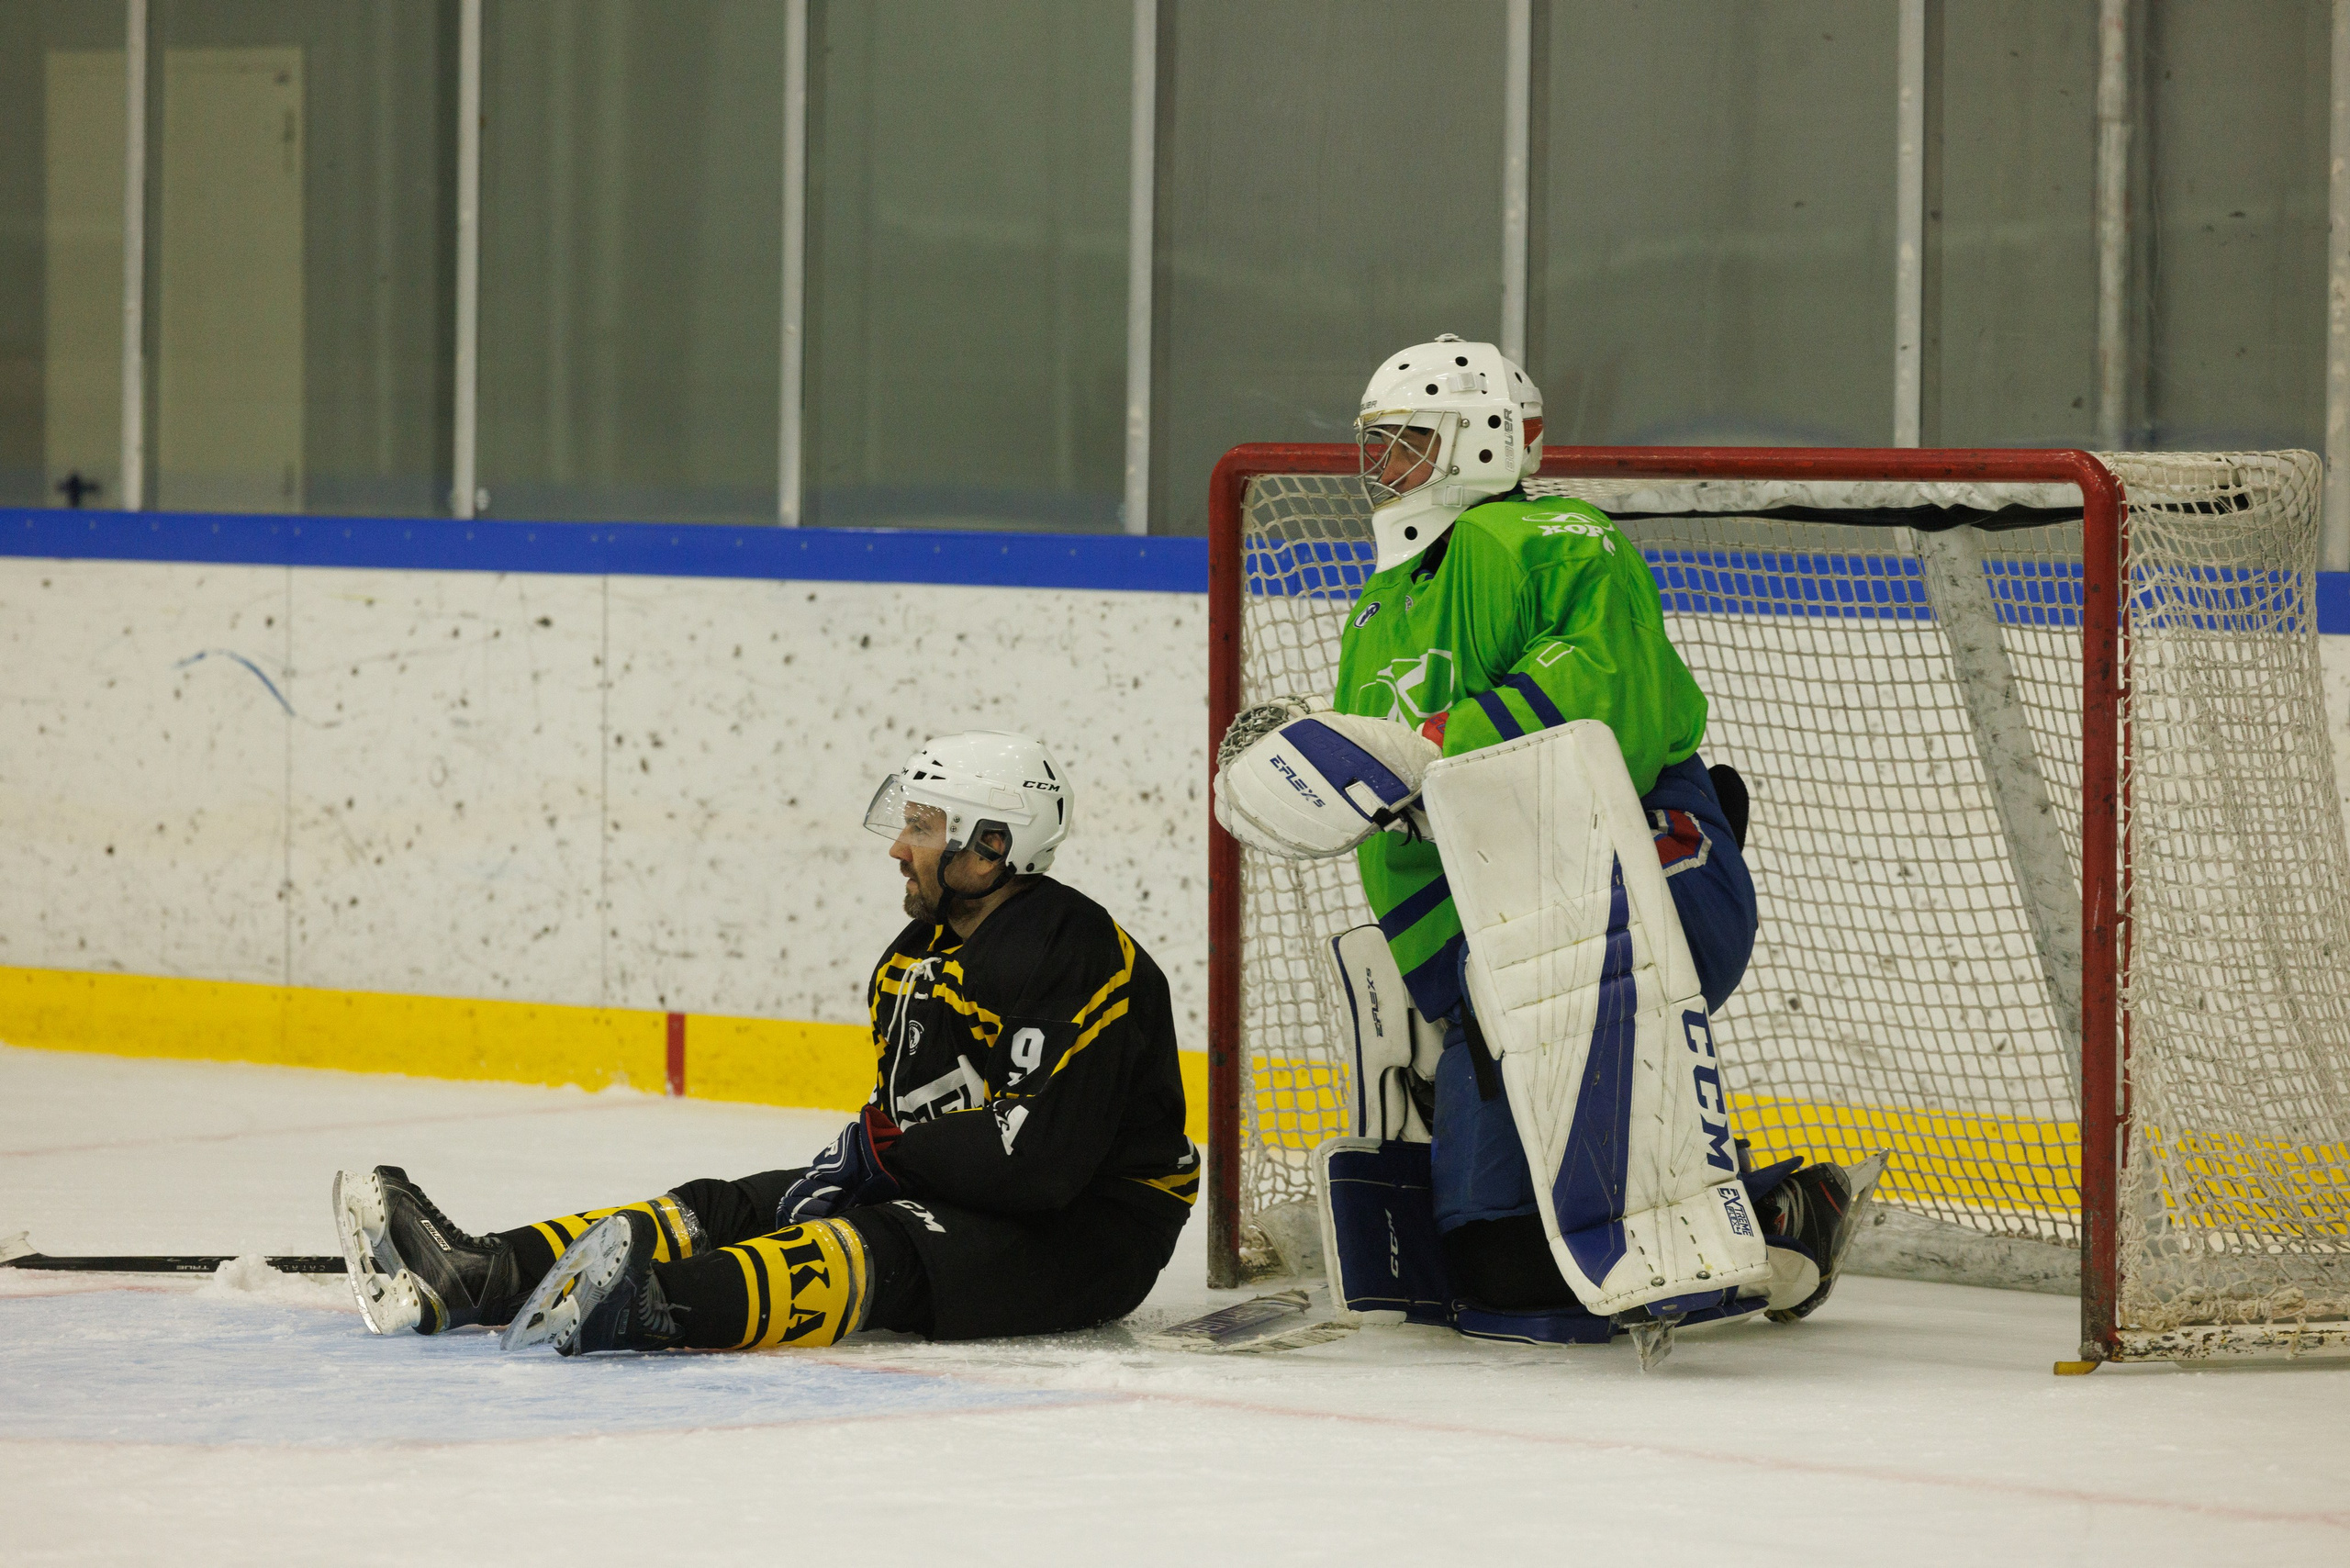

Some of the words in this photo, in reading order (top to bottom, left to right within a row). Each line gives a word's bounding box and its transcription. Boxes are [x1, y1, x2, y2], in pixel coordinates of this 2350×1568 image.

[1023, 780, 1060, 792] CCM
[1681, 1007, 1735, 1172] CCM
[1384, 1207, 1399, 1279] CCM
